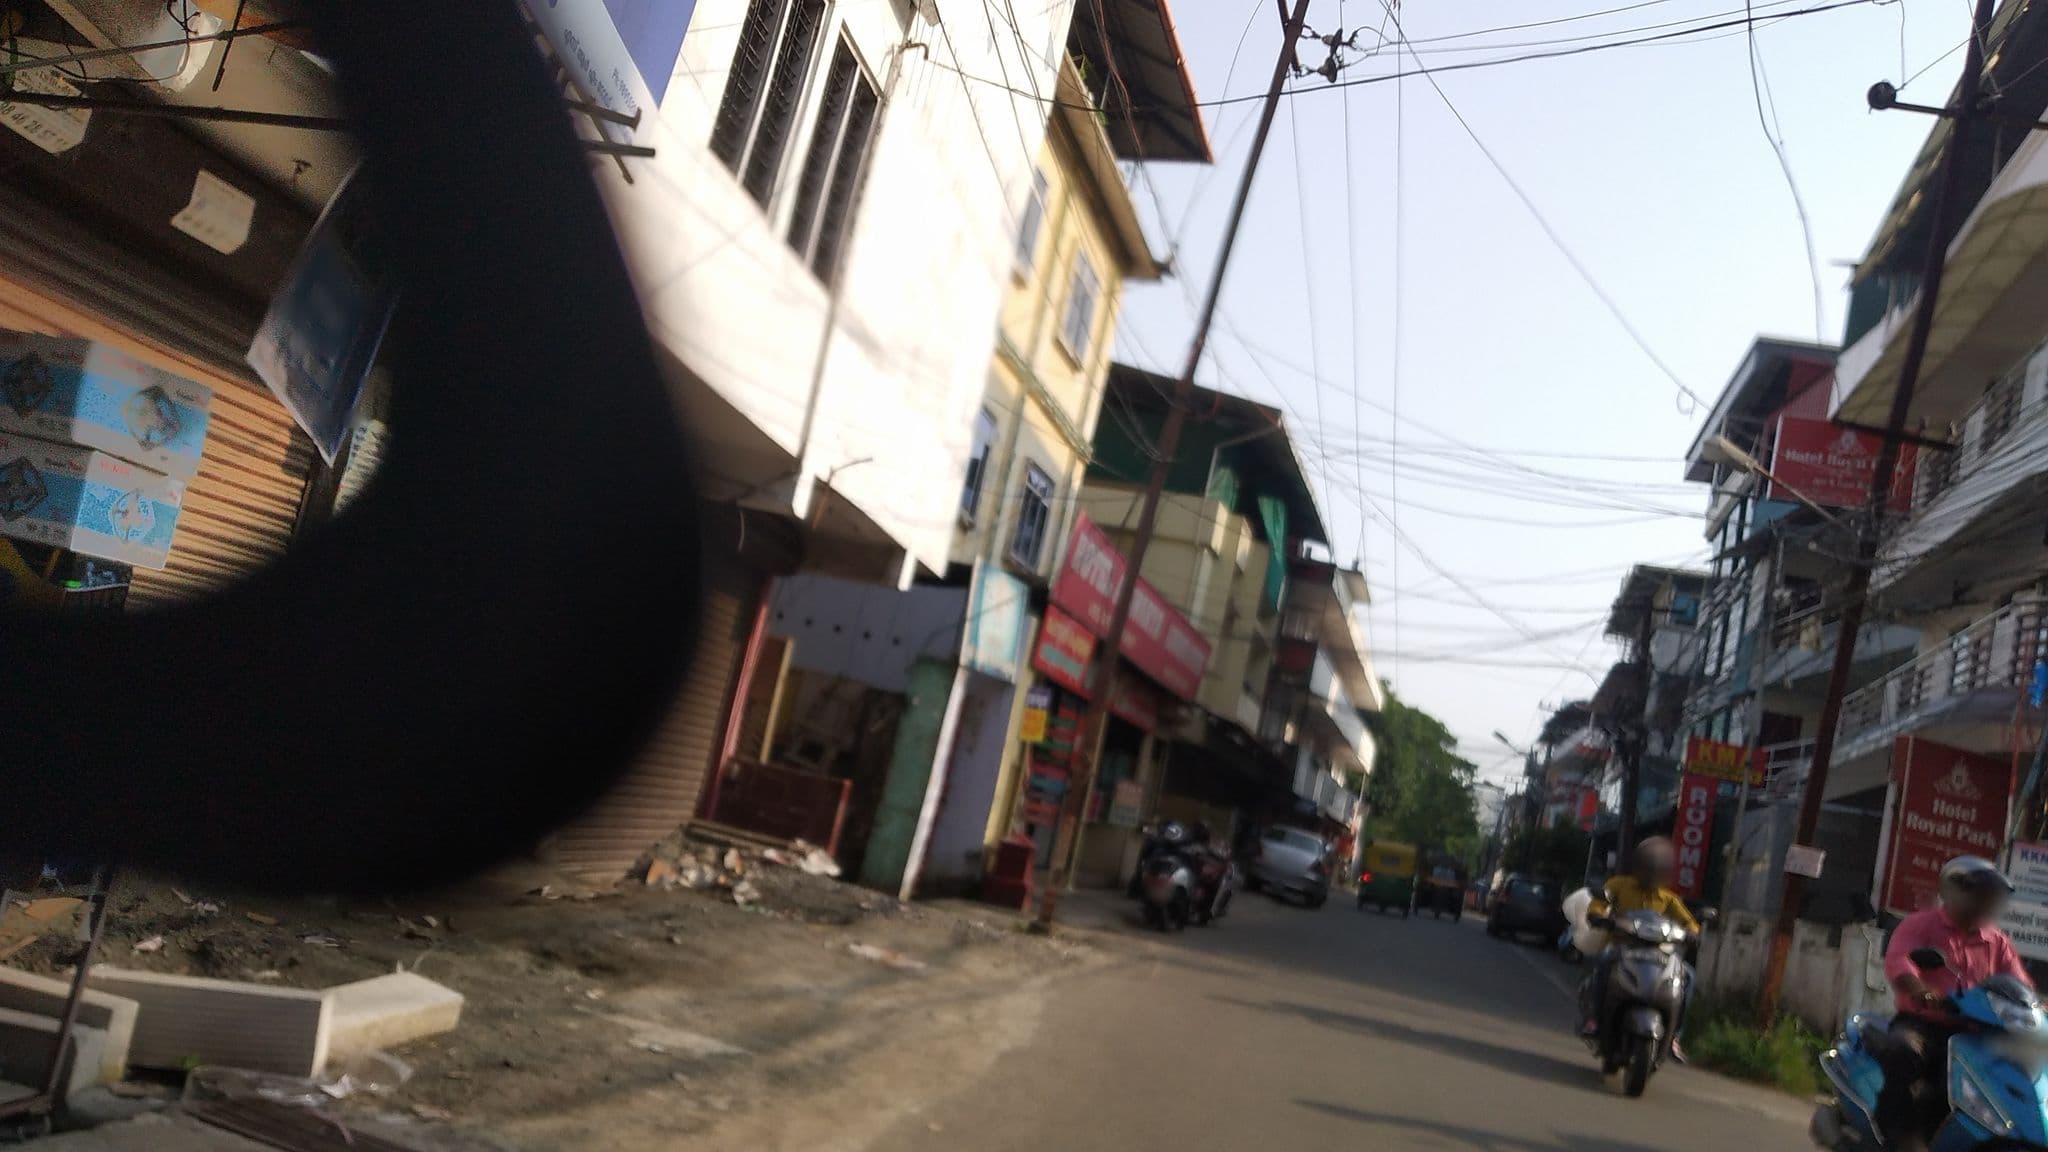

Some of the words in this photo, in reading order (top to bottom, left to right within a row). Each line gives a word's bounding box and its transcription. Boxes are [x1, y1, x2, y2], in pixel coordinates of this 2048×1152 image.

[1932, 797, 1977, 822] Hotel
[1678, 786, 1708, 887] ROOMS
[1906, 811, 1953, 838] Royal
[1956, 823, 1997, 849] Park
